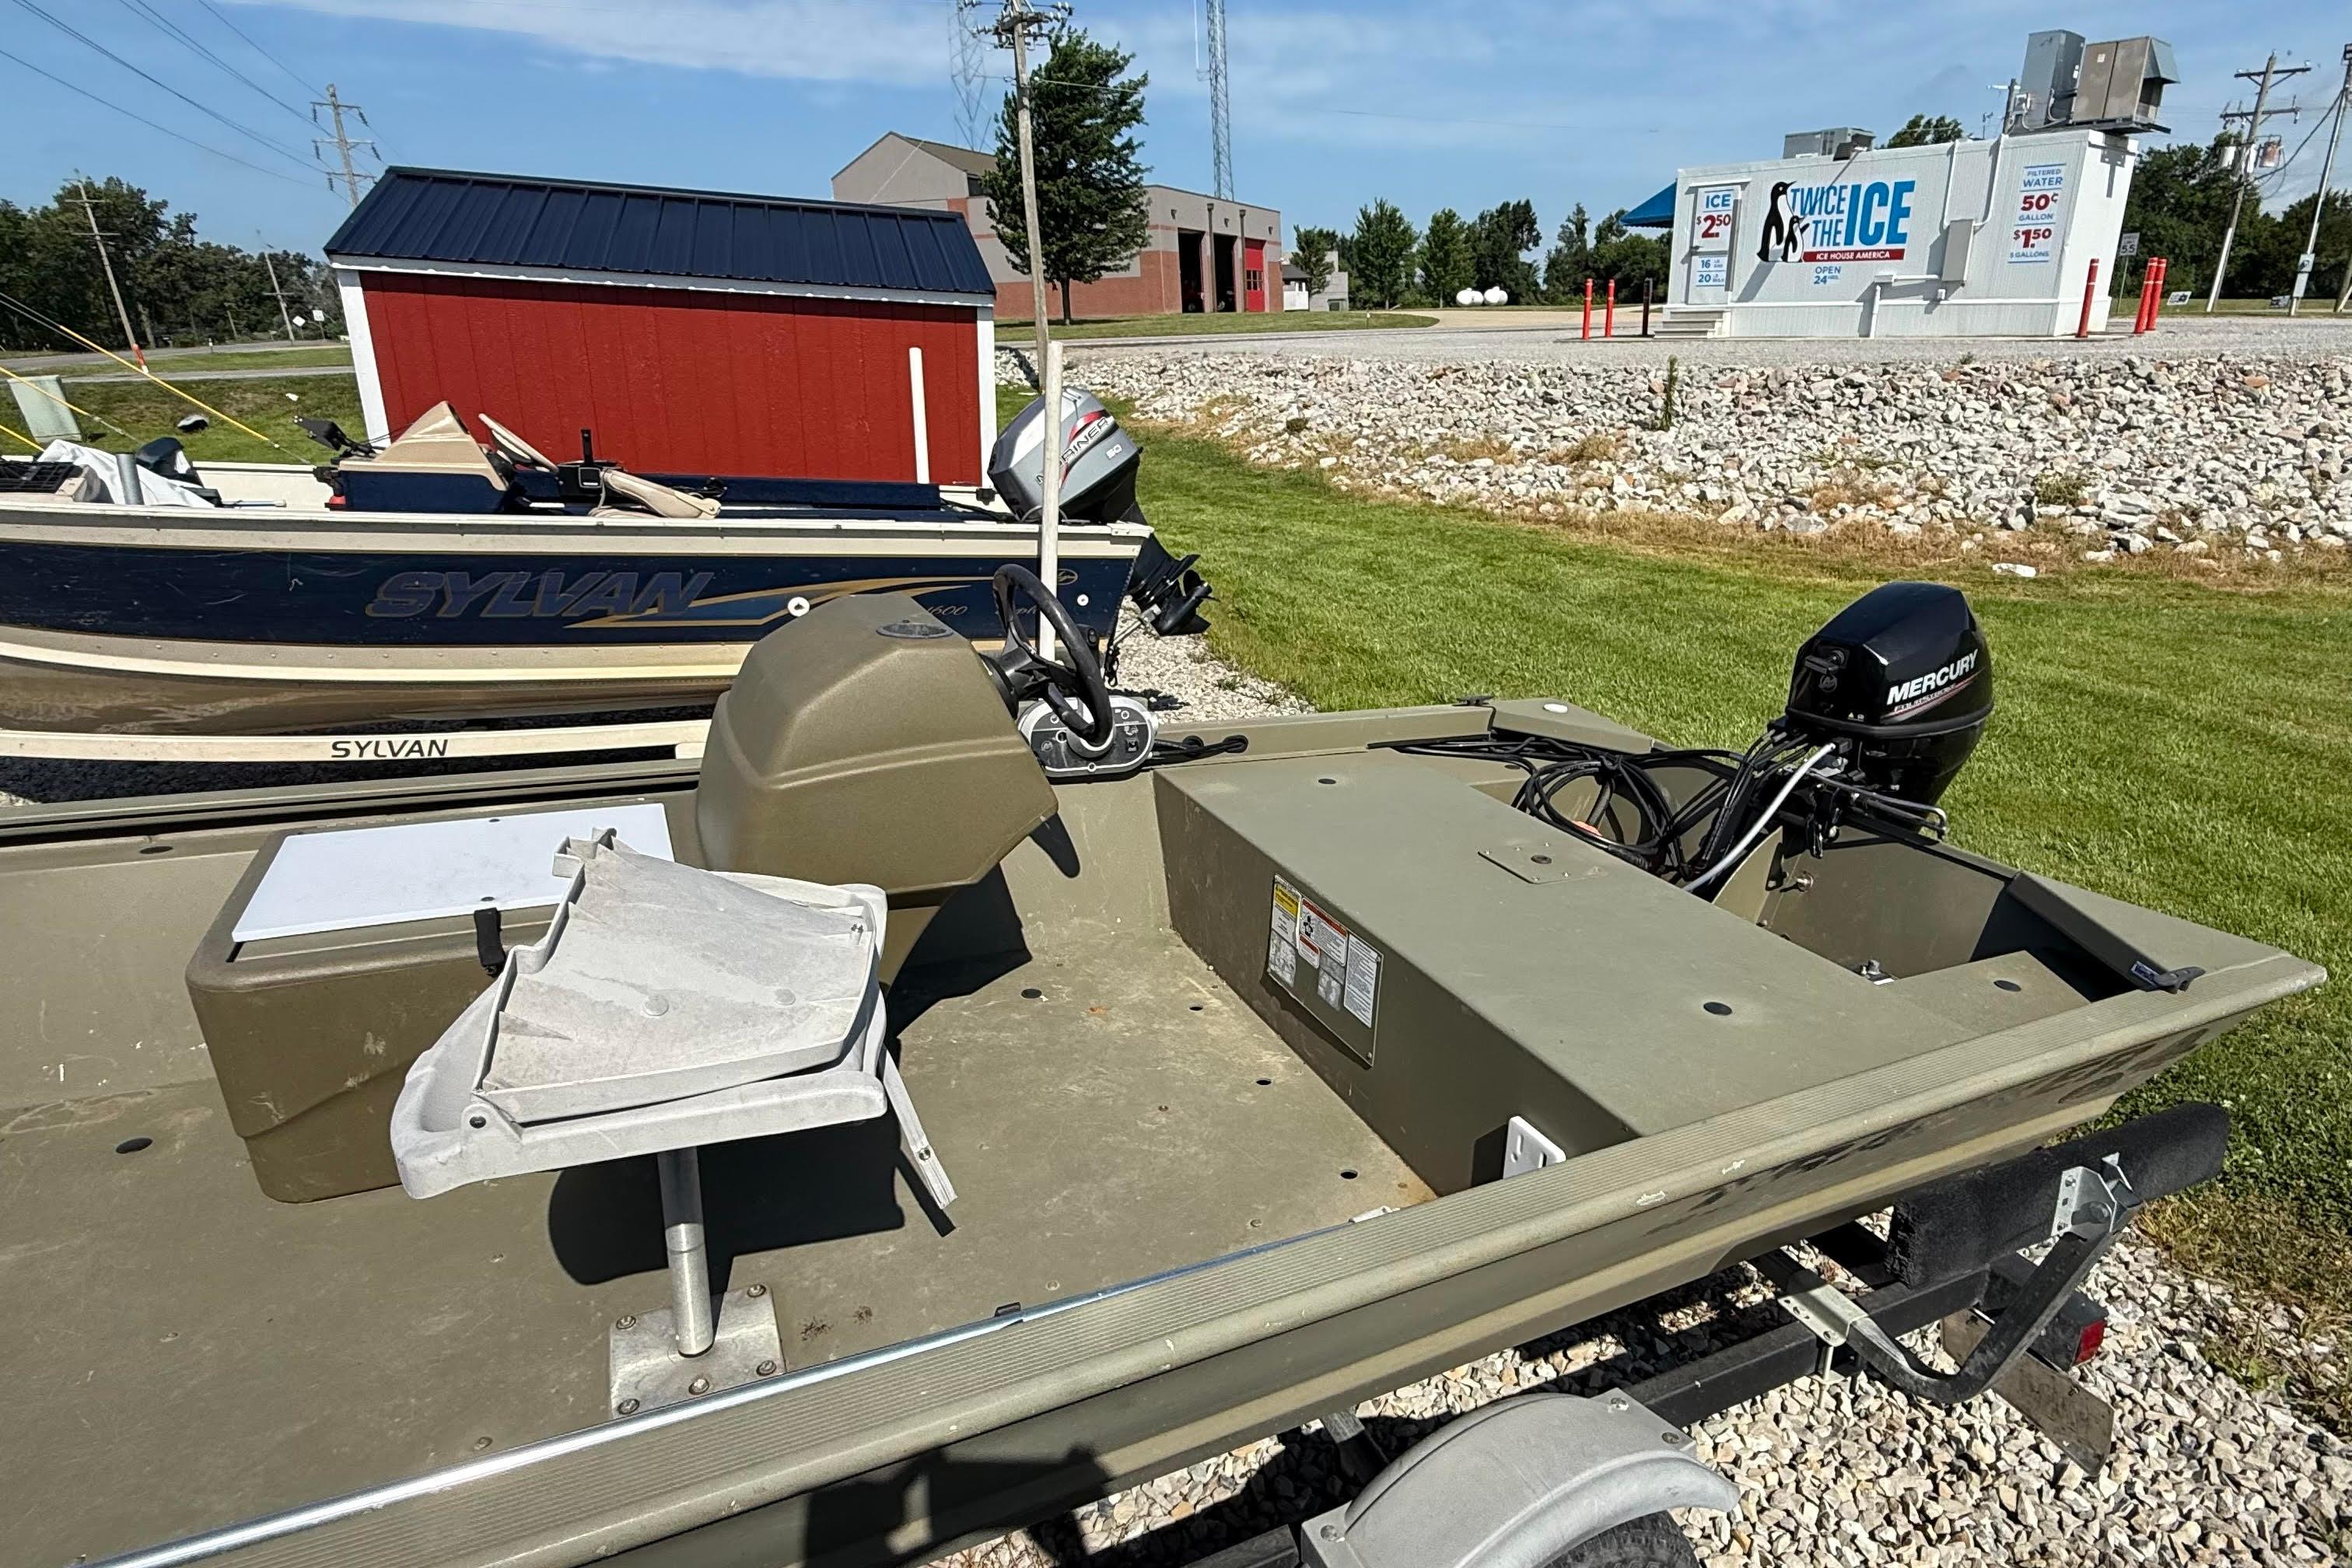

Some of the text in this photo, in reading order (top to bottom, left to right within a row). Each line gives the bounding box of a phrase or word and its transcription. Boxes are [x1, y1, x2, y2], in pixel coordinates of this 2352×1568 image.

[2027, 168, 2061, 177] FILTERED
[2023, 177, 2063, 187] WATER
[1706, 194, 1731, 208] ICE
[1790, 180, 1916, 247] TWICE THE ICE
[2018, 213, 2054, 222] GALLON
[2121, 244, 2135, 254] 55
[1856, 250, 1890, 259] AMERICA
[1701, 259, 1711, 269] 16
[1698, 274, 1711, 283] 20
[1814, 275, 1827, 285] 24
[366, 571, 715, 618] SYLVAN
[1886, 649, 1979, 705] MERCURY
[331, 739, 448, 759] SYLVAN
